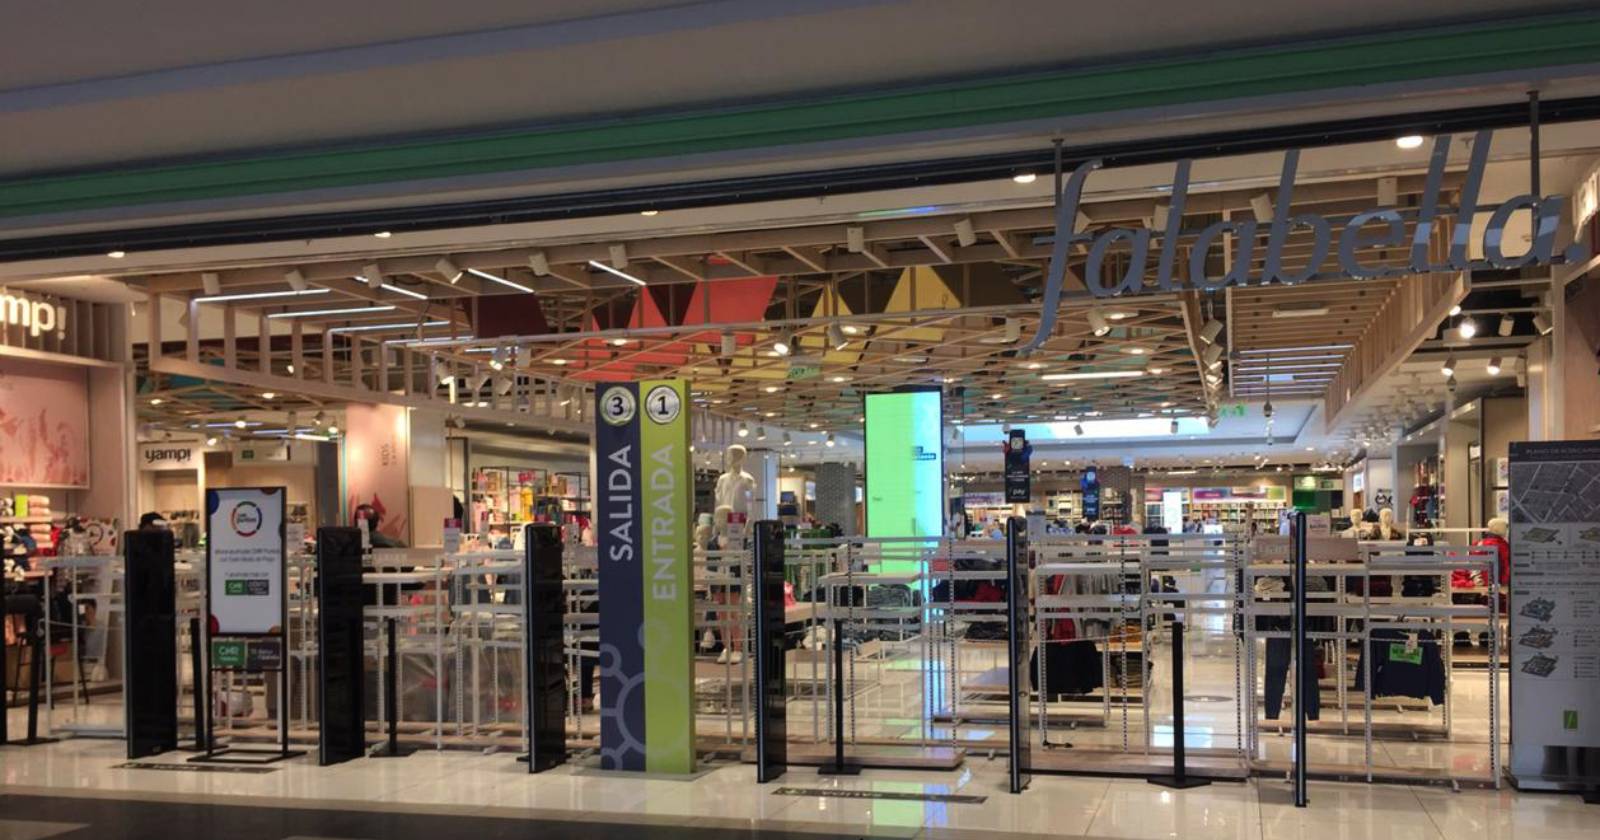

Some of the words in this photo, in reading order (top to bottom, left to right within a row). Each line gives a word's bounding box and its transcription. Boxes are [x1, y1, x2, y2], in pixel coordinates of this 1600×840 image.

[612, 397, 624, 416] 3
[657, 396, 669, 415] 1
[144, 448, 191, 463] yamp!
[608, 445, 634, 561] SALIDA
[651, 444, 676, 601] ENTRADA
